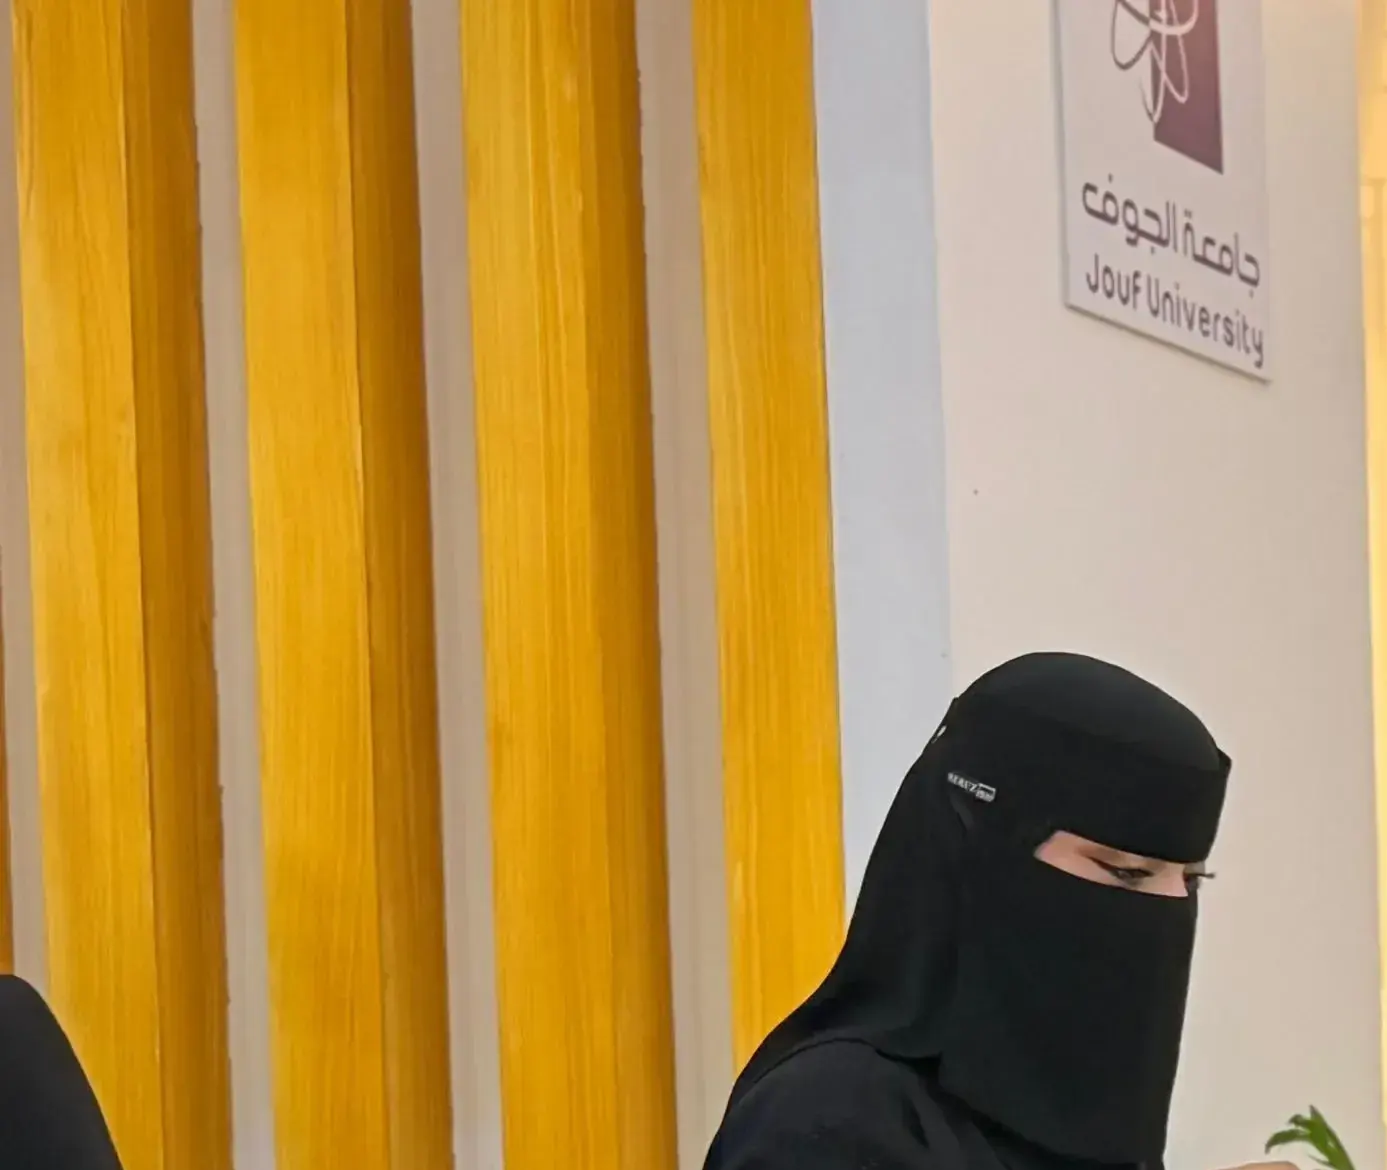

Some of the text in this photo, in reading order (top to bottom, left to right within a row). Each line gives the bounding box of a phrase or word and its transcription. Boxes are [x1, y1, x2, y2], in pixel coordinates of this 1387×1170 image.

[1082, 173, 1260, 298] جامعة الجوف
[1086, 253, 1264, 369] Jouf University
